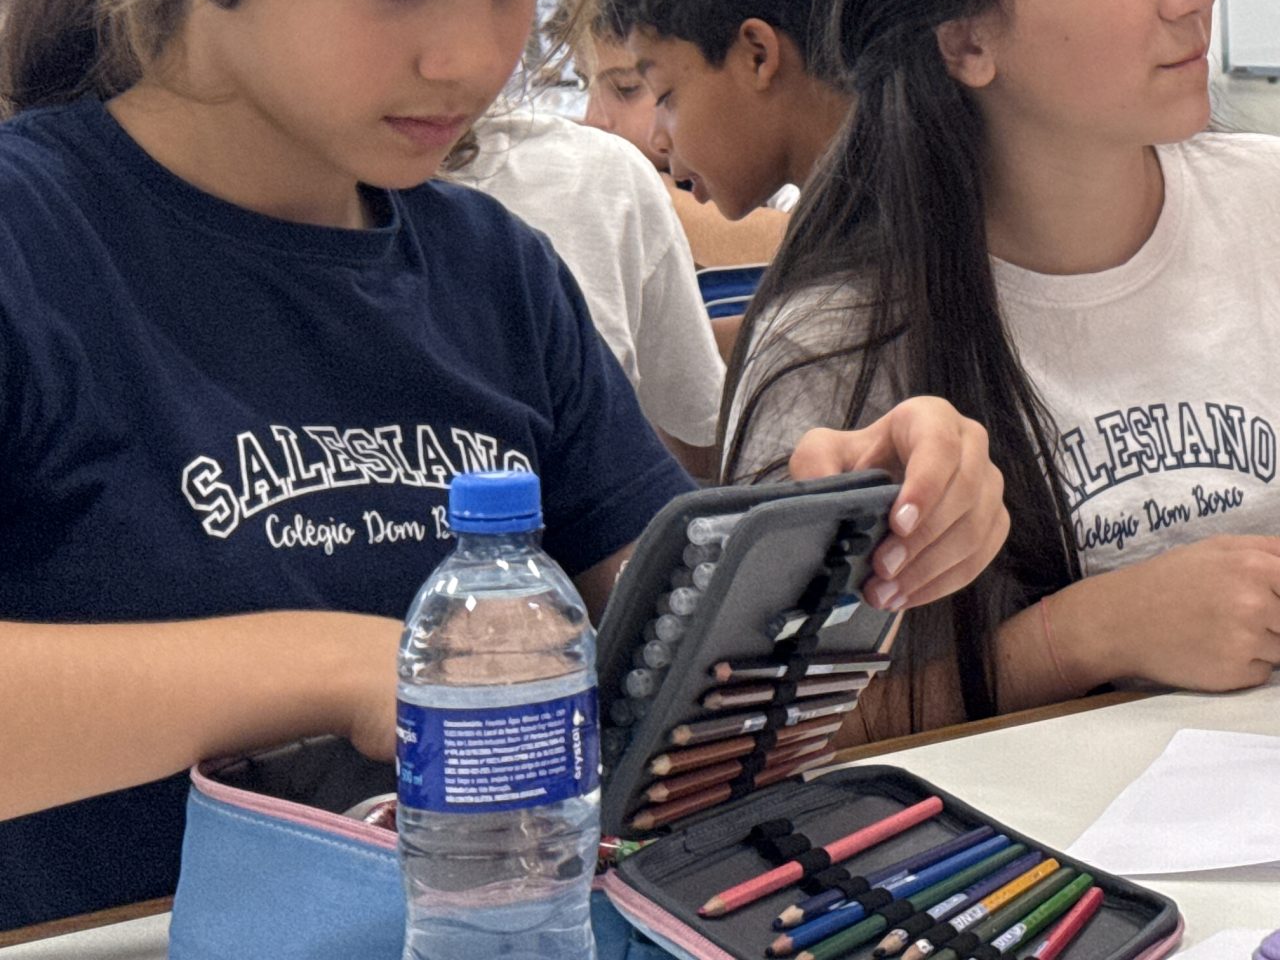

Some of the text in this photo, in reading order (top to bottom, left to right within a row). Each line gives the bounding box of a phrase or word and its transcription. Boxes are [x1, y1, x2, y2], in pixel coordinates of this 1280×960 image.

[266, 513, 355, 555] Colégio
[363, 510, 425, 544] Dom
[1074, 484, 1243, 551] Colégio Dom Bosco
[572, 727, 583, 780] crystal
